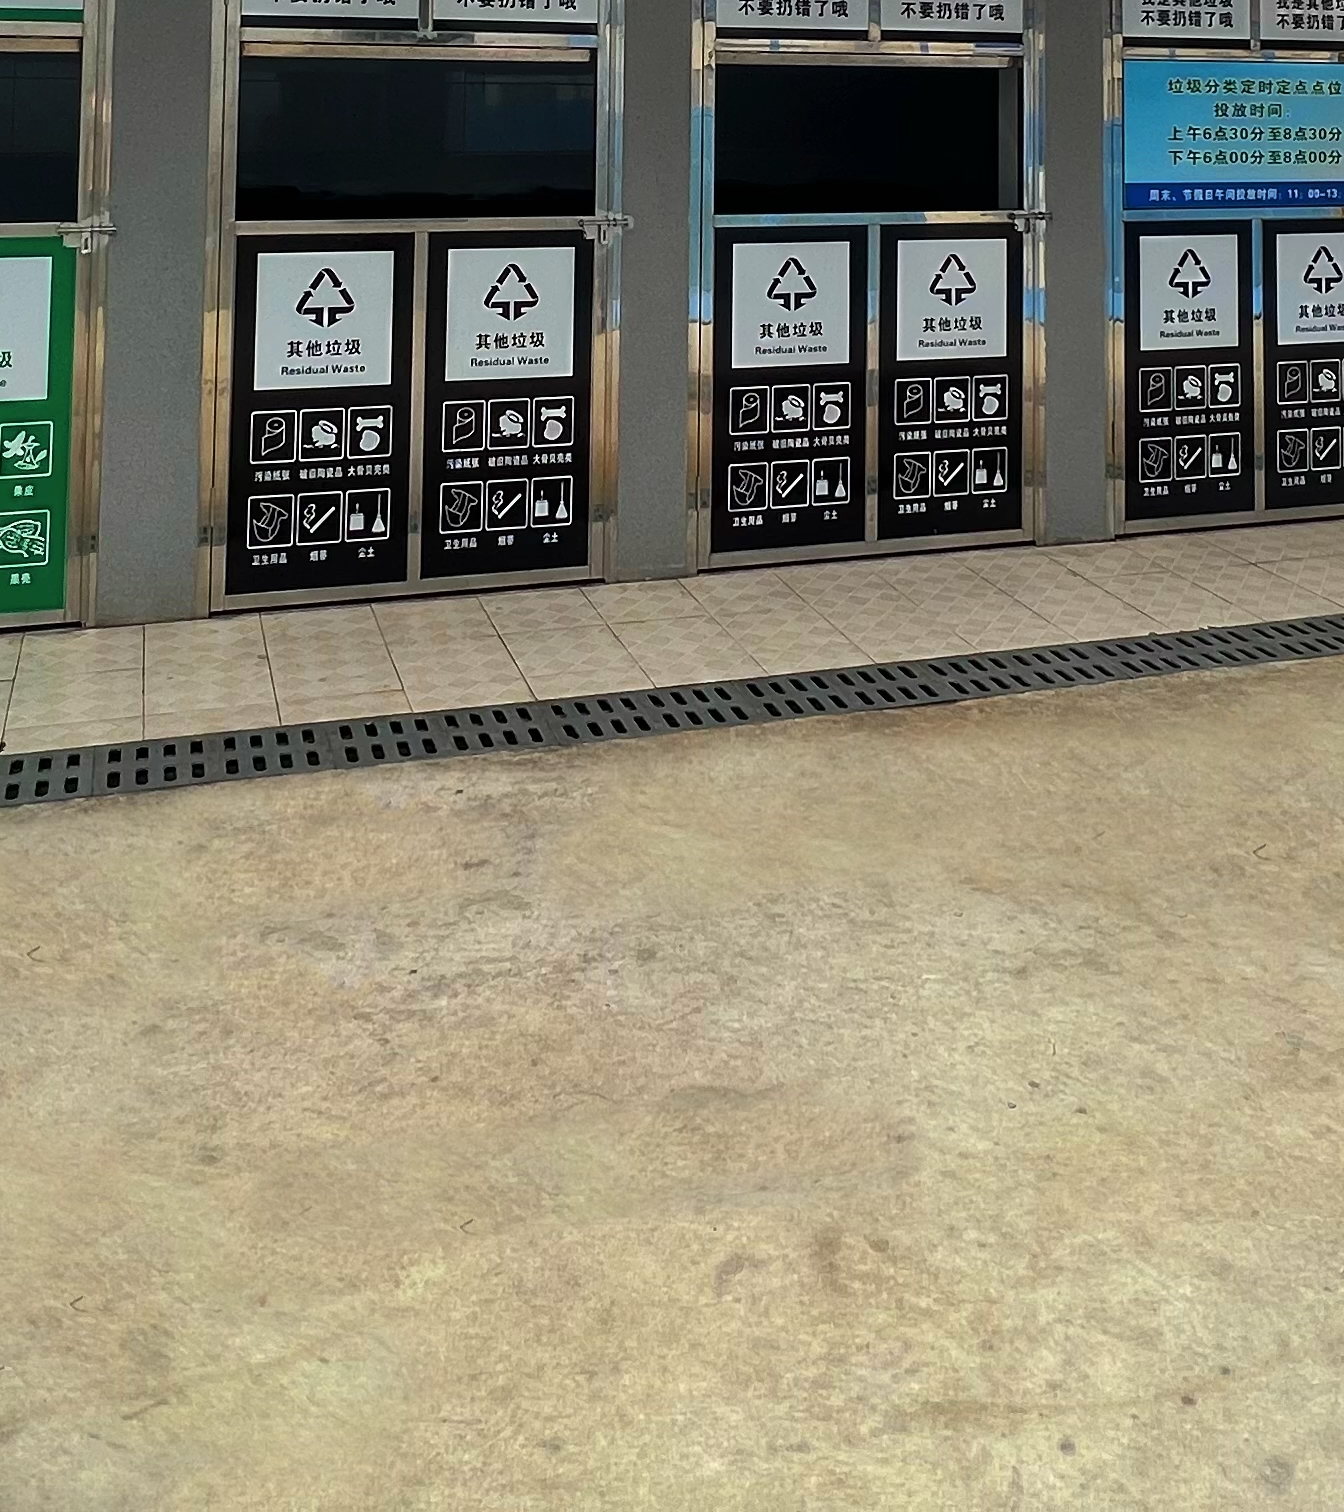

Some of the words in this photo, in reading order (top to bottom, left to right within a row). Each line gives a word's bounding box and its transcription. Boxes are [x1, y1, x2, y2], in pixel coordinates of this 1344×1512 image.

[901, 1, 1004, 20] 不要扔错了哦
[1141, 10, 1233, 27] 不要扔错了哦
[1168, 78, 1342, 96] 垃圾分类定时定点点位
[1213, 102, 1289, 119] 投放时间：
[1168, 126, 1342, 142] 上午6点30分至8点30分
[1169, 150, 1342, 165] 下午6点00分至8点00分
[1163, 308, 1216, 323] 其他垃圾
[760, 322, 823, 338] 其他垃圾
[923, 316, 982, 332] 其他垃圾
[287, 339, 361, 357] 其他垃圾
[476, 332, 544, 349] 其他垃圾
[754, 346, 795, 354] Residual
[797, 345, 827, 353] Waste
[470, 357, 515, 366] Residual
[517, 357, 549, 365] Waste
[280, 366, 328, 375] Residual
[332, 365, 365, 373] Waste
